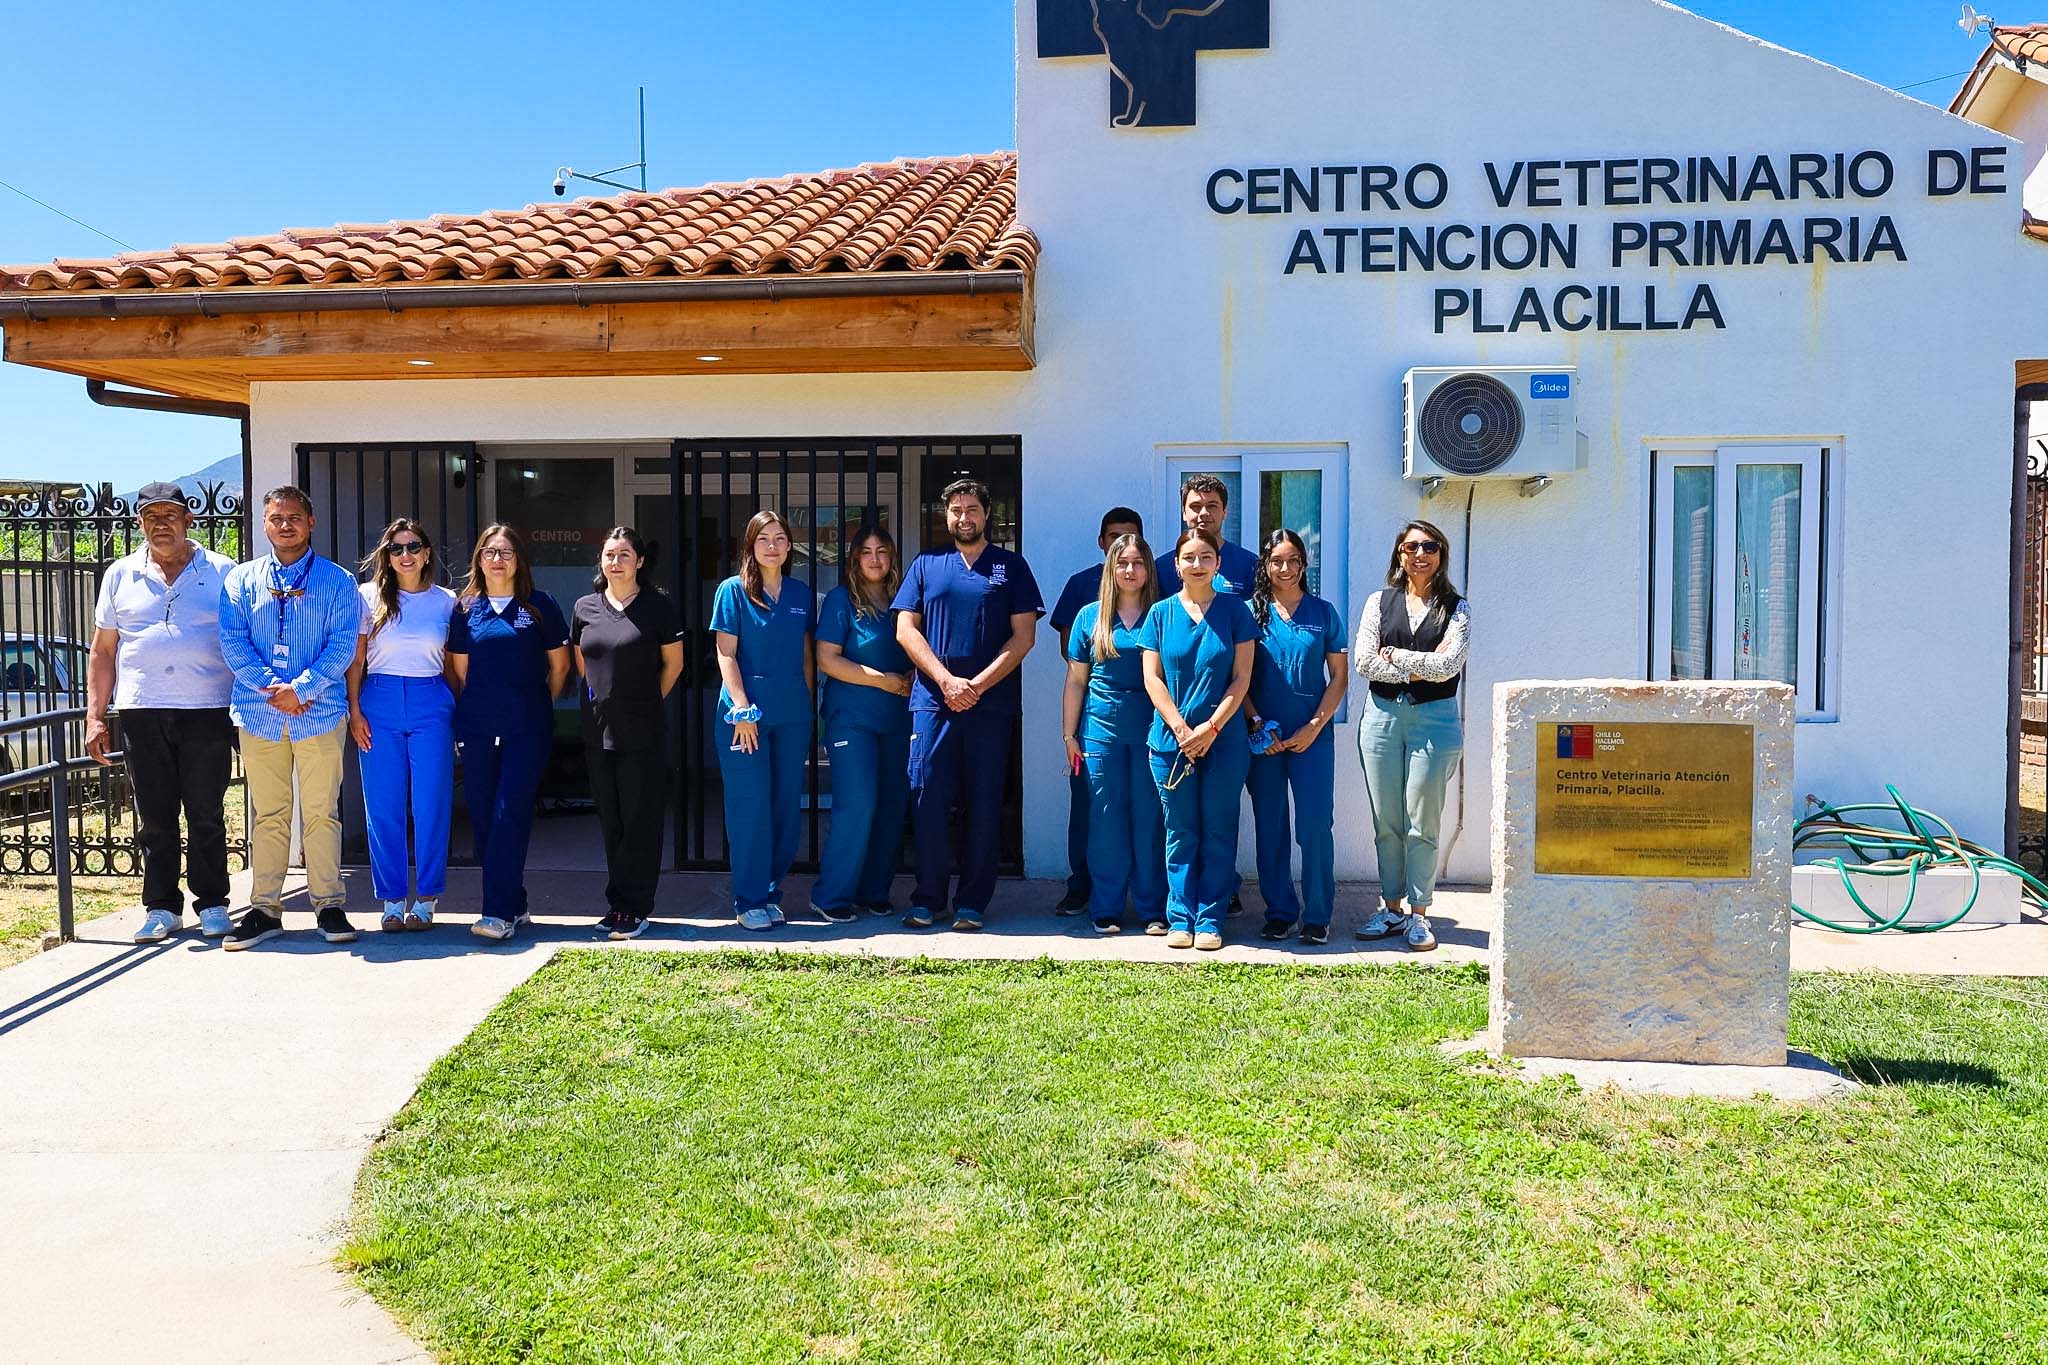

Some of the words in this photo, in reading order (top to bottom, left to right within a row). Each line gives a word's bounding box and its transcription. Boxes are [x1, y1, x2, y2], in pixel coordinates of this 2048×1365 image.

[1206, 163, 1448, 215] CENTRO
[1484, 151, 1893, 208] VETERINARIO
[1928, 147, 2006, 196] DE
[1284, 222, 1577, 275] ATENCION
[1613, 215, 1907, 268] PRIMARIA
[1435, 284, 1726, 333] PLACILLA
[1533, 380, 1567, 393] Midea
[531, 530, 582, 542] CENTRO
[1556, 769, 1598, 781] Centro
[1601, 769, 1671, 781] Veterinario
[1674, 771, 1730, 782] Atención
[1556, 783, 1612, 796] Primaria,
[1617, 784, 1666, 796] Placilla.
